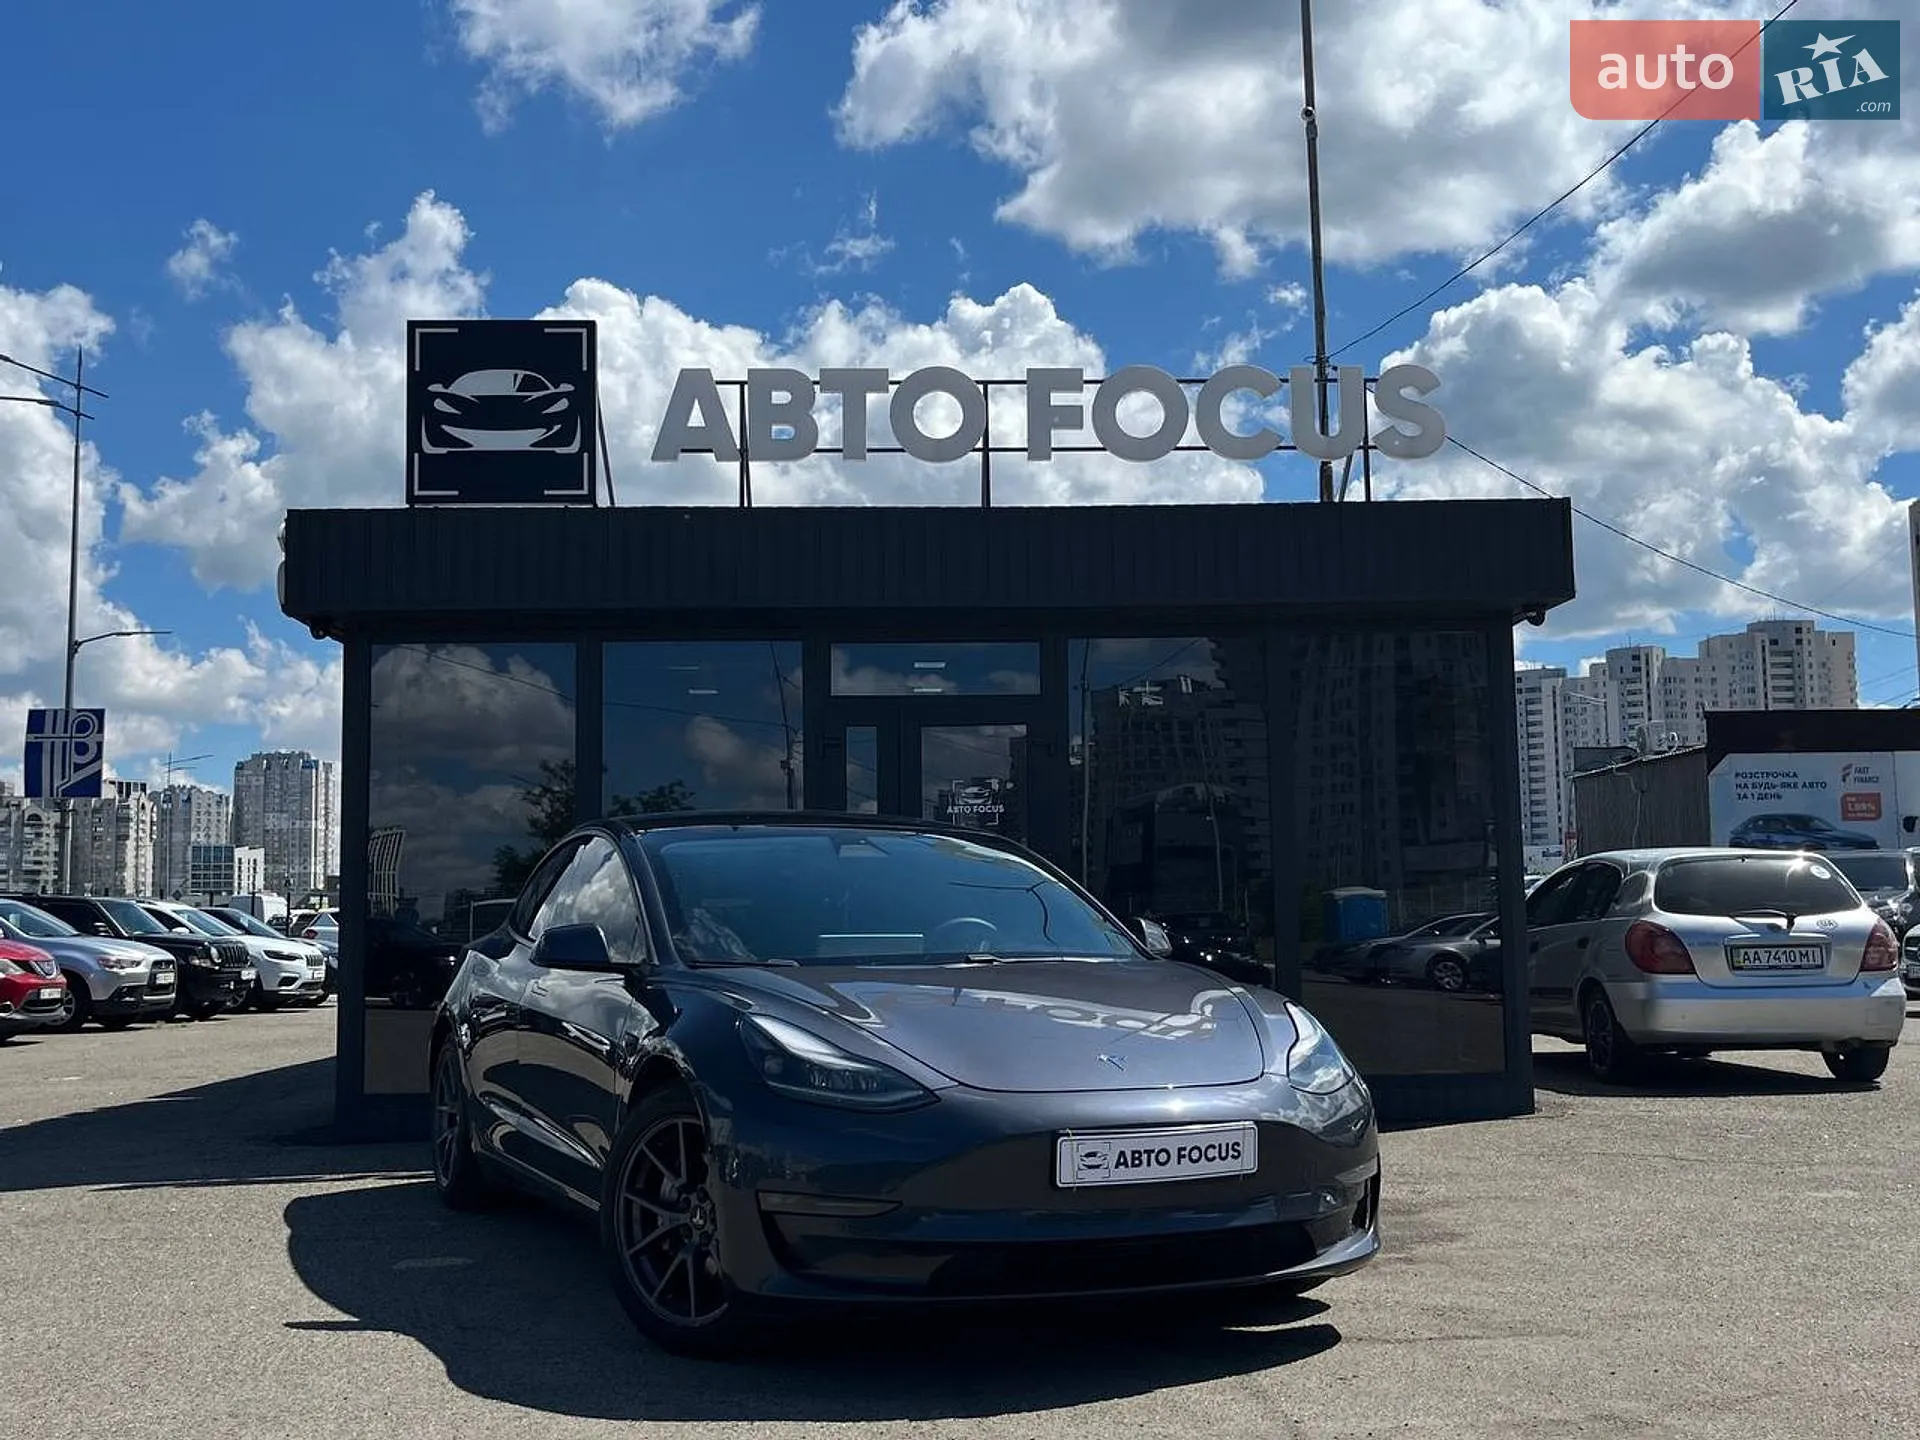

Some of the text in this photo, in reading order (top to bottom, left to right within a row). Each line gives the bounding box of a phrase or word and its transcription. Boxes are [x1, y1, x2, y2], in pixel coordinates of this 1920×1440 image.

[651, 364, 1447, 463] АВТО FOCUS
[1734, 771, 1799, 780] РОЗСТРОЧКА
[1735, 781, 1827, 790] НА БУДЬ-ЯКЕ АВТО
[1736, 792, 1749, 800] ЗА
[1756, 792, 1783, 801] ДЕНЬ
[973, 804, 1005, 813] FOCUS
[1742, 950, 1762, 964] AA
[1764, 949, 1797, 963] 7410
[1114, 1141, 1242, 1170] АВТО FOCUS
